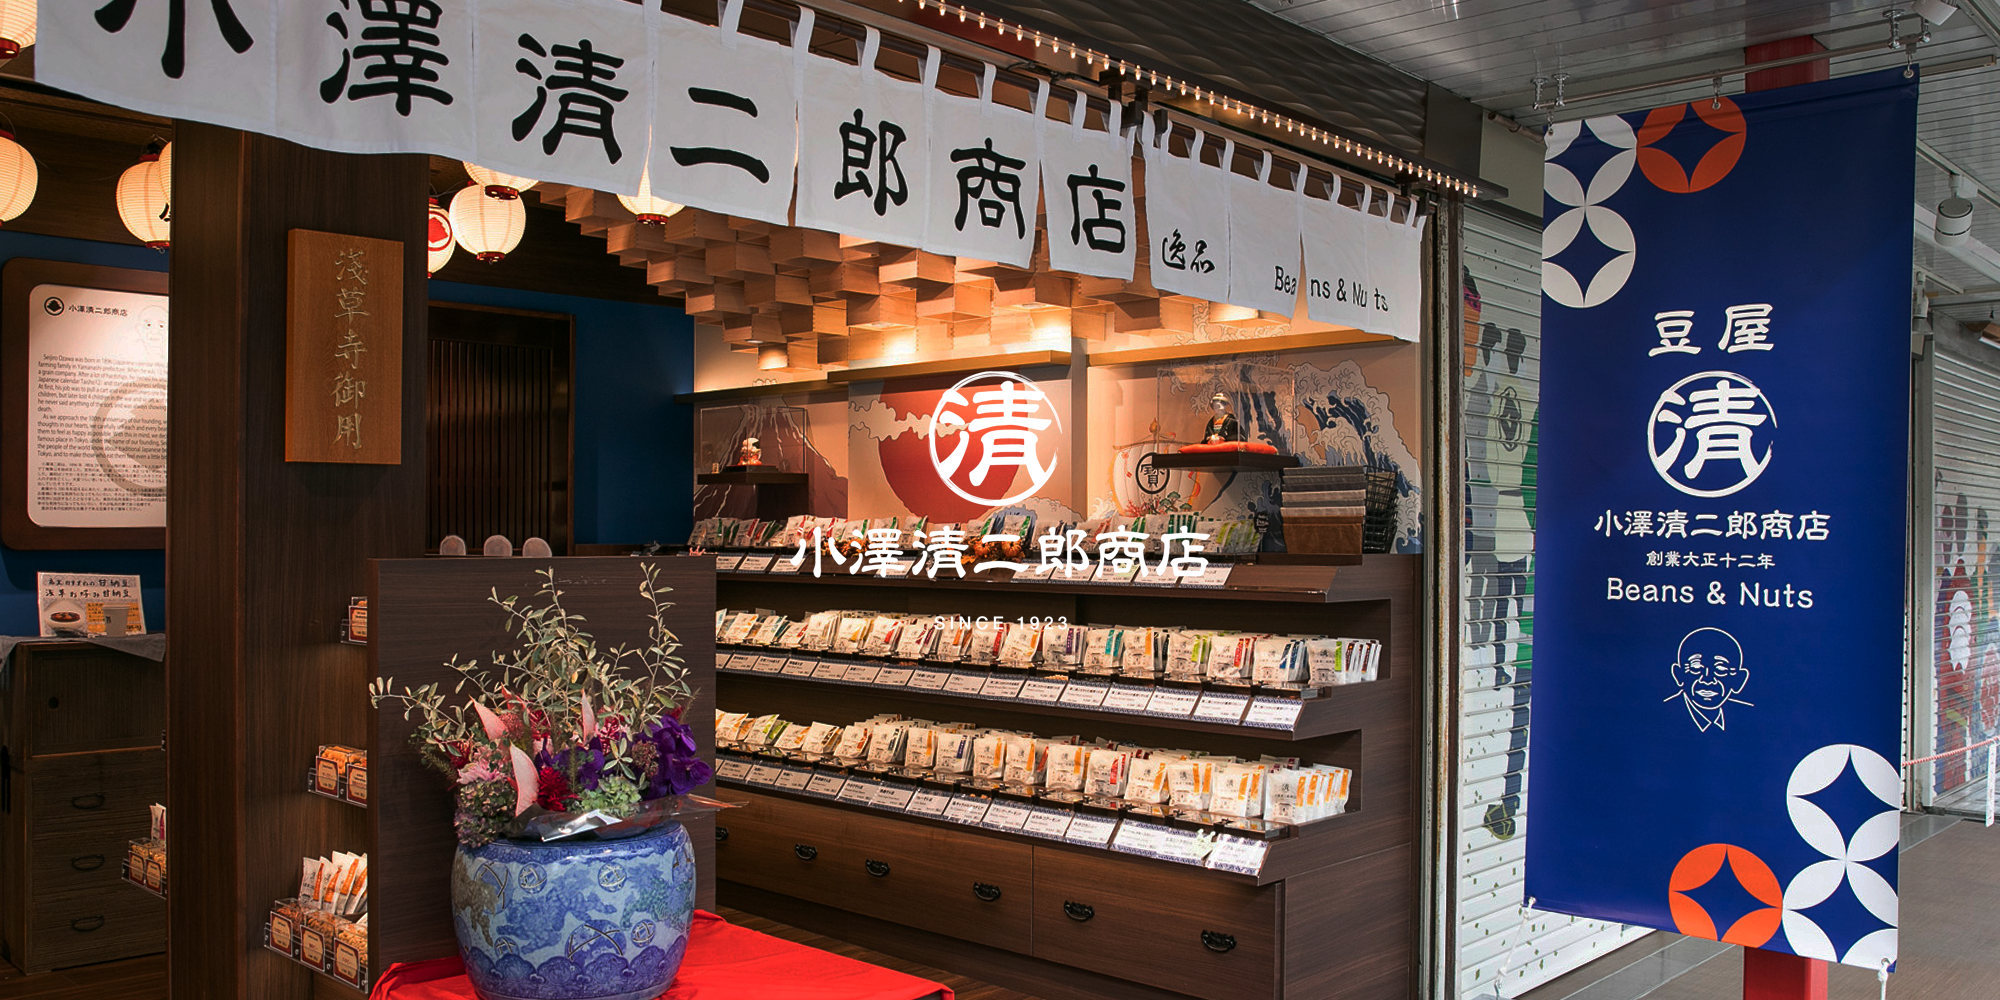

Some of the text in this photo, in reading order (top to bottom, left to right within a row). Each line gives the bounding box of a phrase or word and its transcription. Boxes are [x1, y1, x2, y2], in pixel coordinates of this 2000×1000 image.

[1336, 277, 1347, 302] &
[1352, 281, 1389, 312] Nuts
[1648, 303, 1775, 357] 豆屋
[1652, 374, 1771, 487] 清
[1594, 509, 1832, 541] 小澤清二郎商店
[1646, 550, 1776, 569] 創業大正十二年
[1607, 577, 1814, 609] Beans & Nuts
